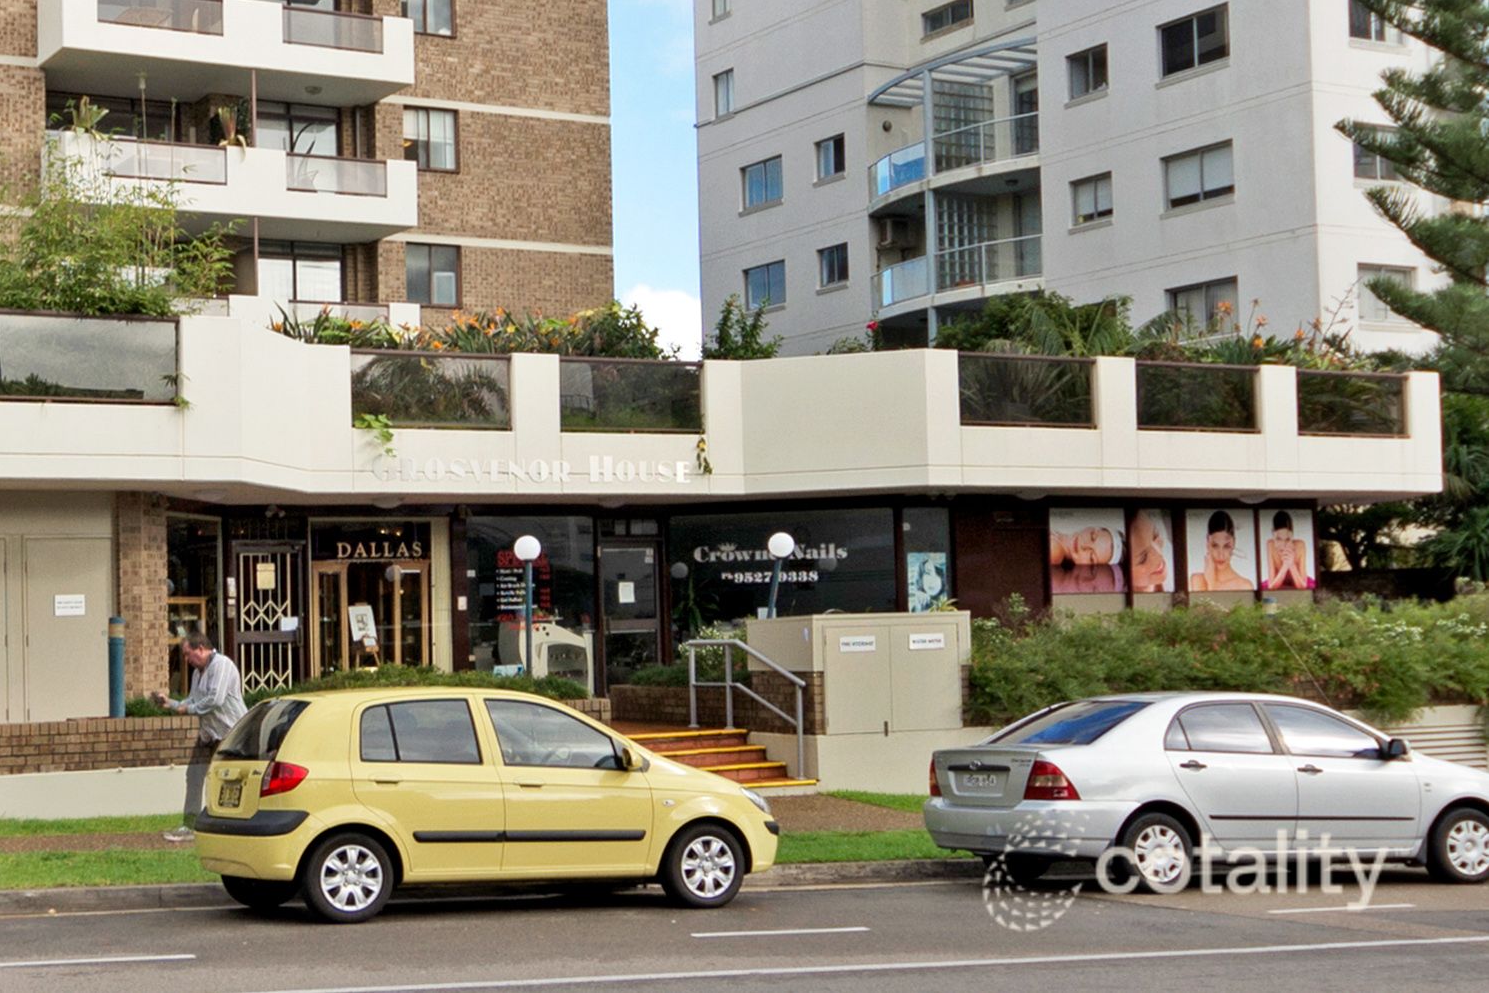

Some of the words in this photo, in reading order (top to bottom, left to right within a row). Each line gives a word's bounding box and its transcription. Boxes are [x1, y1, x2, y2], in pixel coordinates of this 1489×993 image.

[372, 453, 571, 484] GROSVENOR
[588, 455, 692, 484] HOUSE
[336, 541, 423, 558] DALLAS
[790, 542, 848, 559] Nails
